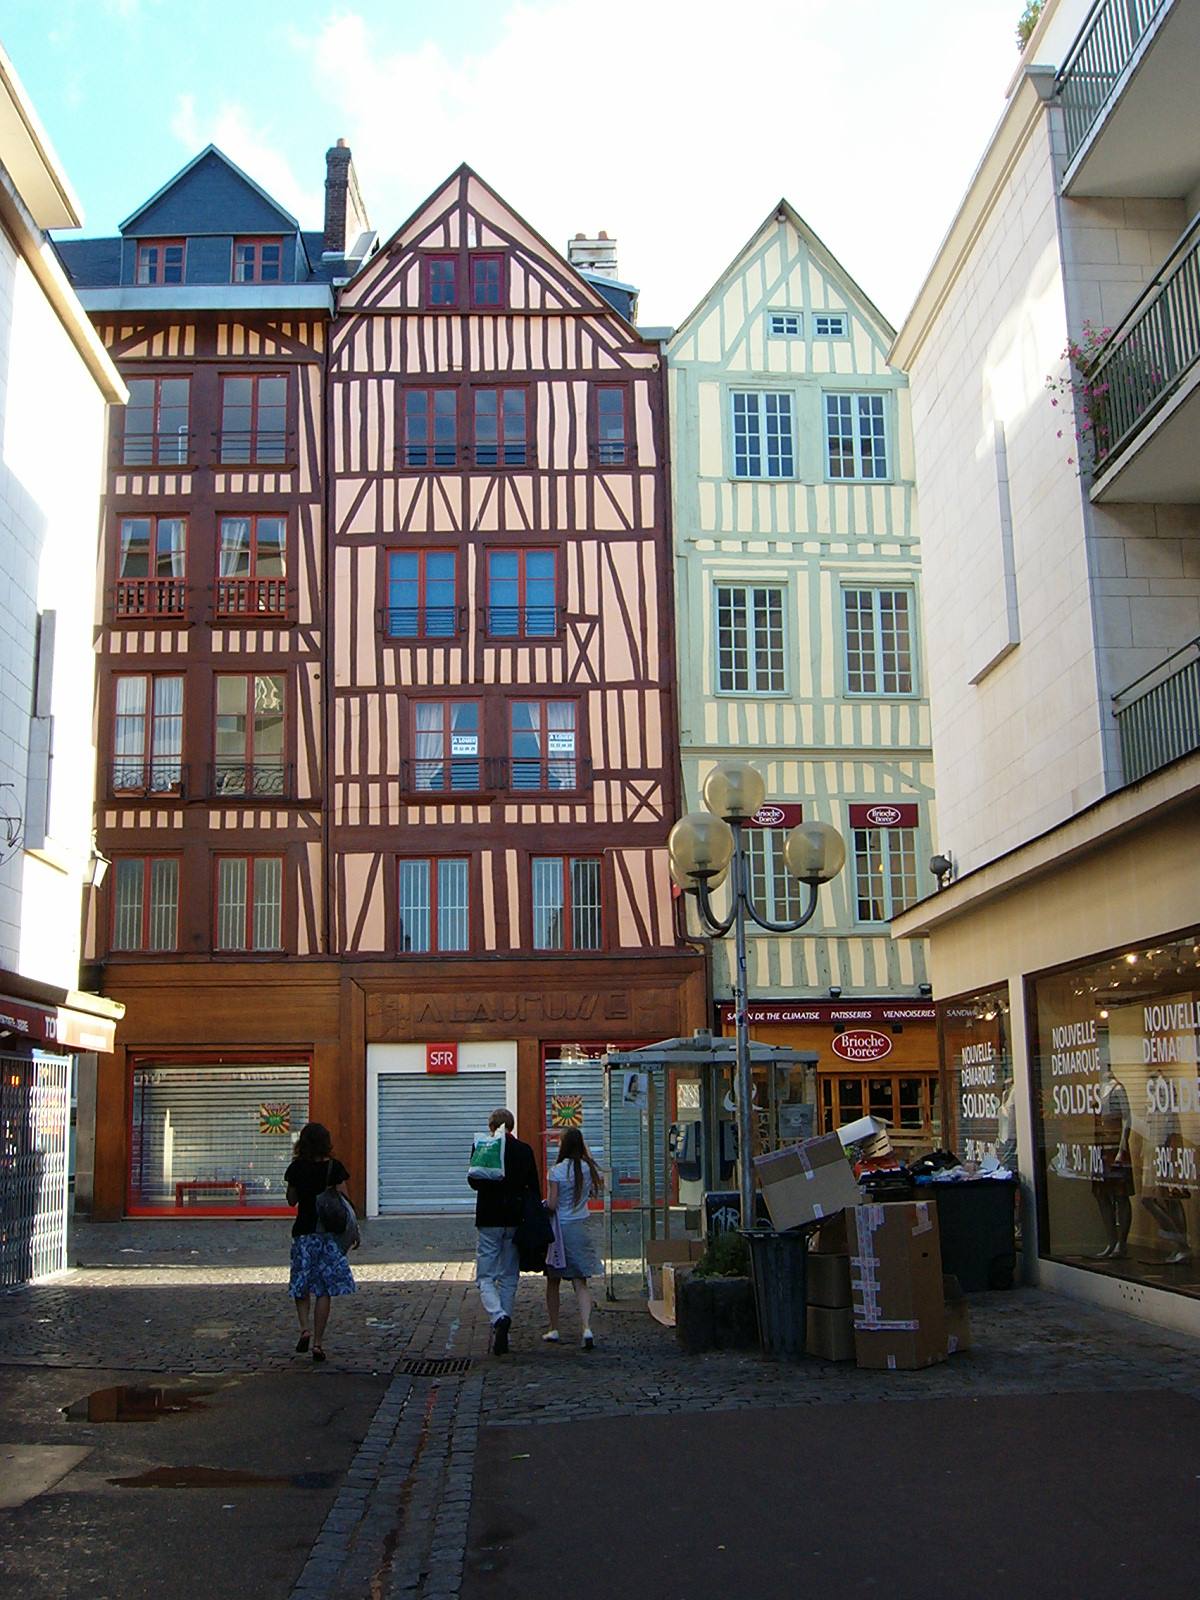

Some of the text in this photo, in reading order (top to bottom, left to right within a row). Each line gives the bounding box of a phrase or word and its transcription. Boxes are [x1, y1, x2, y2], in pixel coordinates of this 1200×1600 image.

[727, 1012, 753, 1020] SAN
[754, 1012, 764, 1020] DE
[766, 1012, 780, 1020] THE
[782, 1012, 820, 1020] CLIMATISE
[830, 1010, 872, 1019] PATISSERIES
[883, 1009, 936, 1019] VIENNOISERIES
[841, 1034, 885, 1048] Brioche
[1052, 1020, 1096, 1049] NOUVELLE
[430, 1051, 454, 1065] SFR
[962, 1042, 992, 1064] NOUVELLE
[1051, 1048, 1100, 1076] DÉMARQUE
[963, 1093, 996, 1118] SOLDES
[1053, 1083, 1101, 1114] SOLDES
